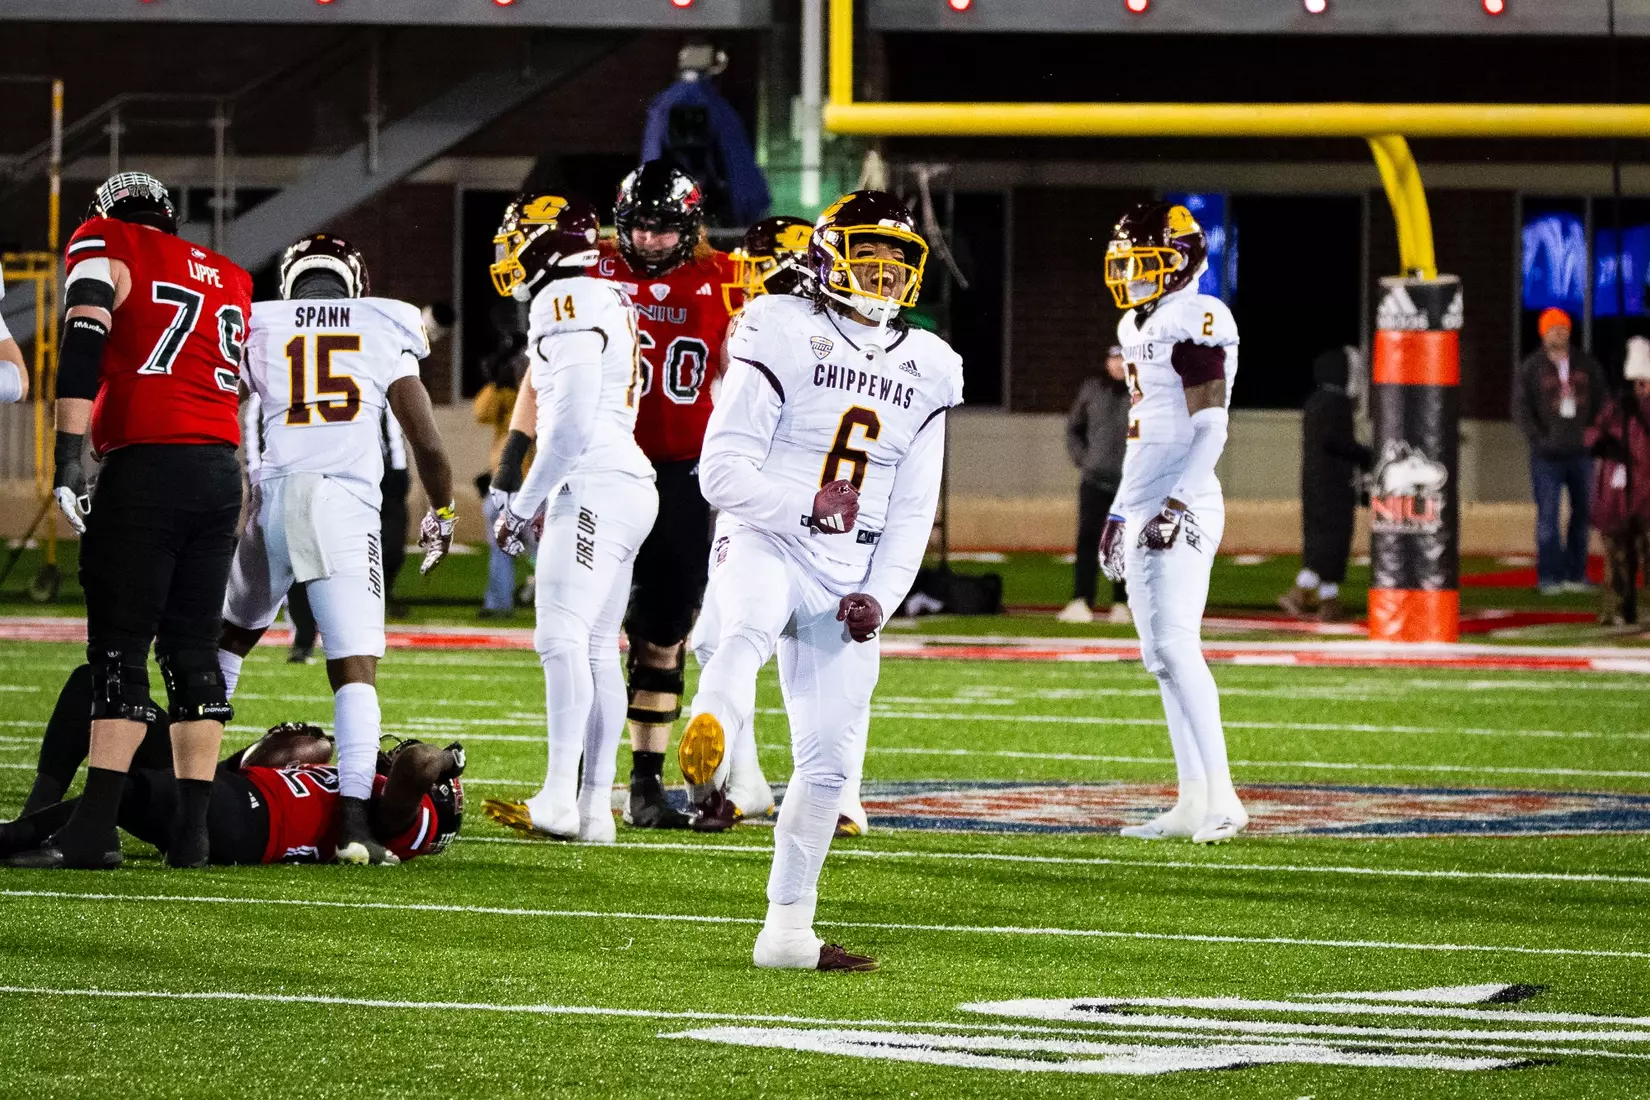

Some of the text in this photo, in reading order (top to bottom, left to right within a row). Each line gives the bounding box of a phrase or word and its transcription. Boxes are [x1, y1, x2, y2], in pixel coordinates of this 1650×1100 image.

[187, 259, 224, 289] LIPPE
[599, 257, 616, 277] C
[294, 306, 351, 328] SPANN
[553, 294, 576, 322] 14
[635, 302, 688, 324] NIU
[1201, 311, 1215, 337] 2
[137, 280, 245, 396] 79
[284, 333, 362, 426] 15
[813, 364, 915, 409] CHIPPEWAS
[818, 404, 882, 493] 6
[576, 505, 599, 571] FIRE UP!
[367, 532, 382, 599] FIRE UP!
